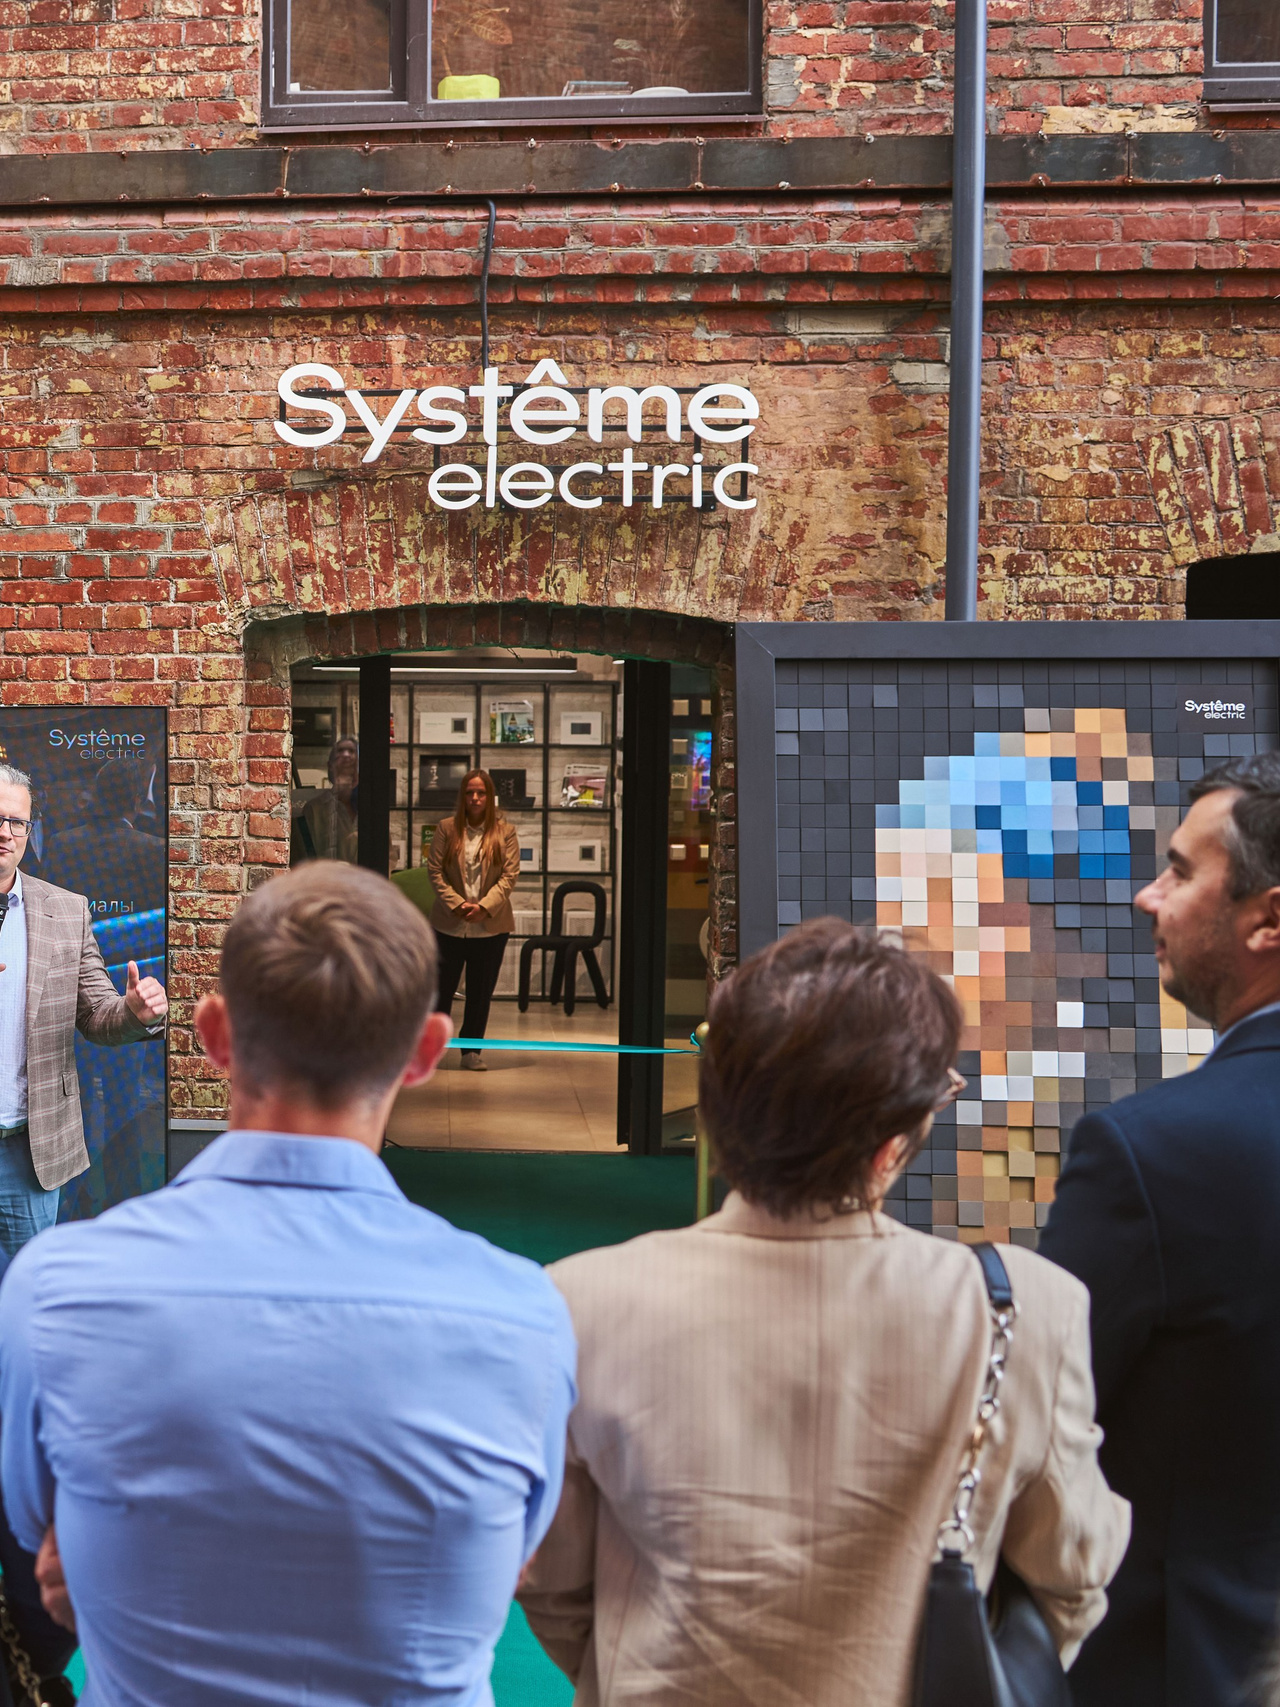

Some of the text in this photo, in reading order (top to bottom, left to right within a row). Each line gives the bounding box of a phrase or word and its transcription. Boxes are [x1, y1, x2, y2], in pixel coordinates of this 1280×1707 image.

[273, 358, 760, 463] Système
[428, 446, 759, 510] electric
[1184, 700, 1245, 713] Système
[1204, 711, 1245, 719] electric
[49, 728, 145, 749] Système
[80, 747, 145, 759] electric
